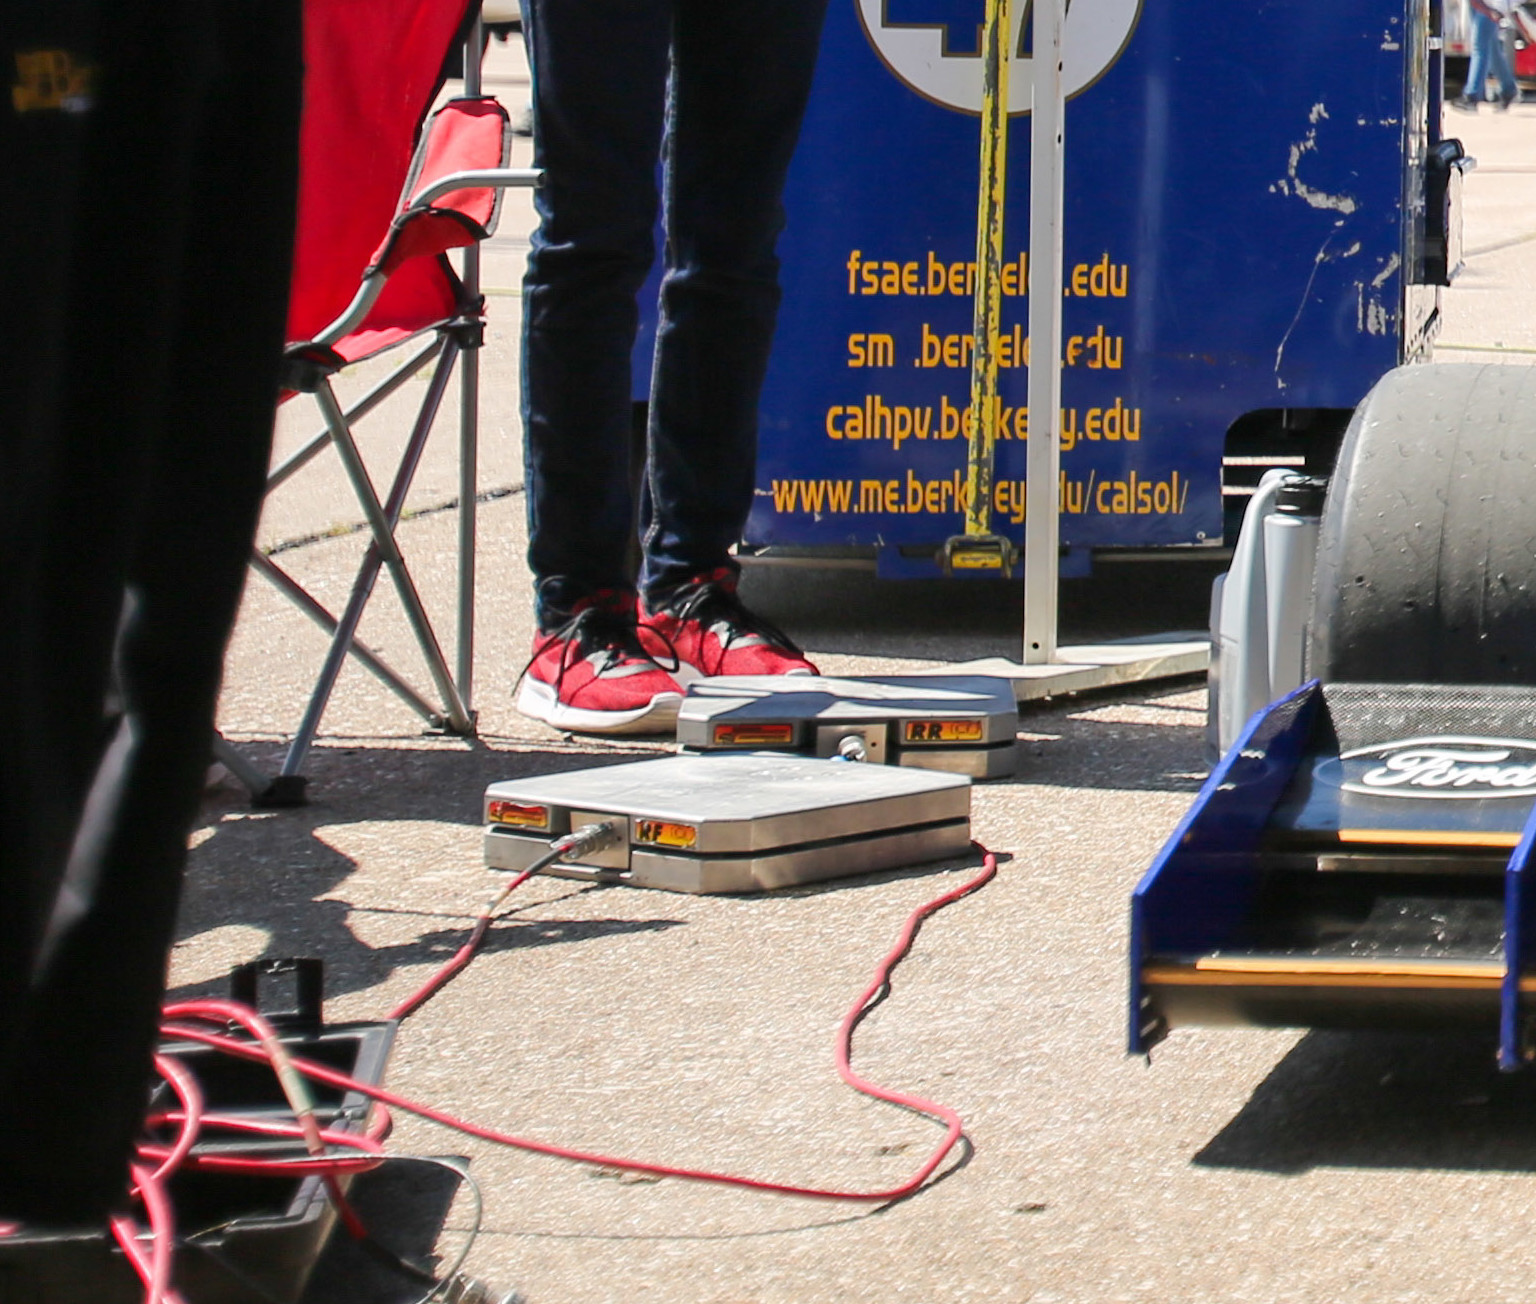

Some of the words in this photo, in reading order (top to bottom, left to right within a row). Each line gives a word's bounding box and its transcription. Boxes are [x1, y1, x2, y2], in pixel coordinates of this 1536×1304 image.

[847, 250, 1128, 297] fsae.berel.edu
[910, 722, 943, 740] RR
[639, 821, 664, 842] RF
